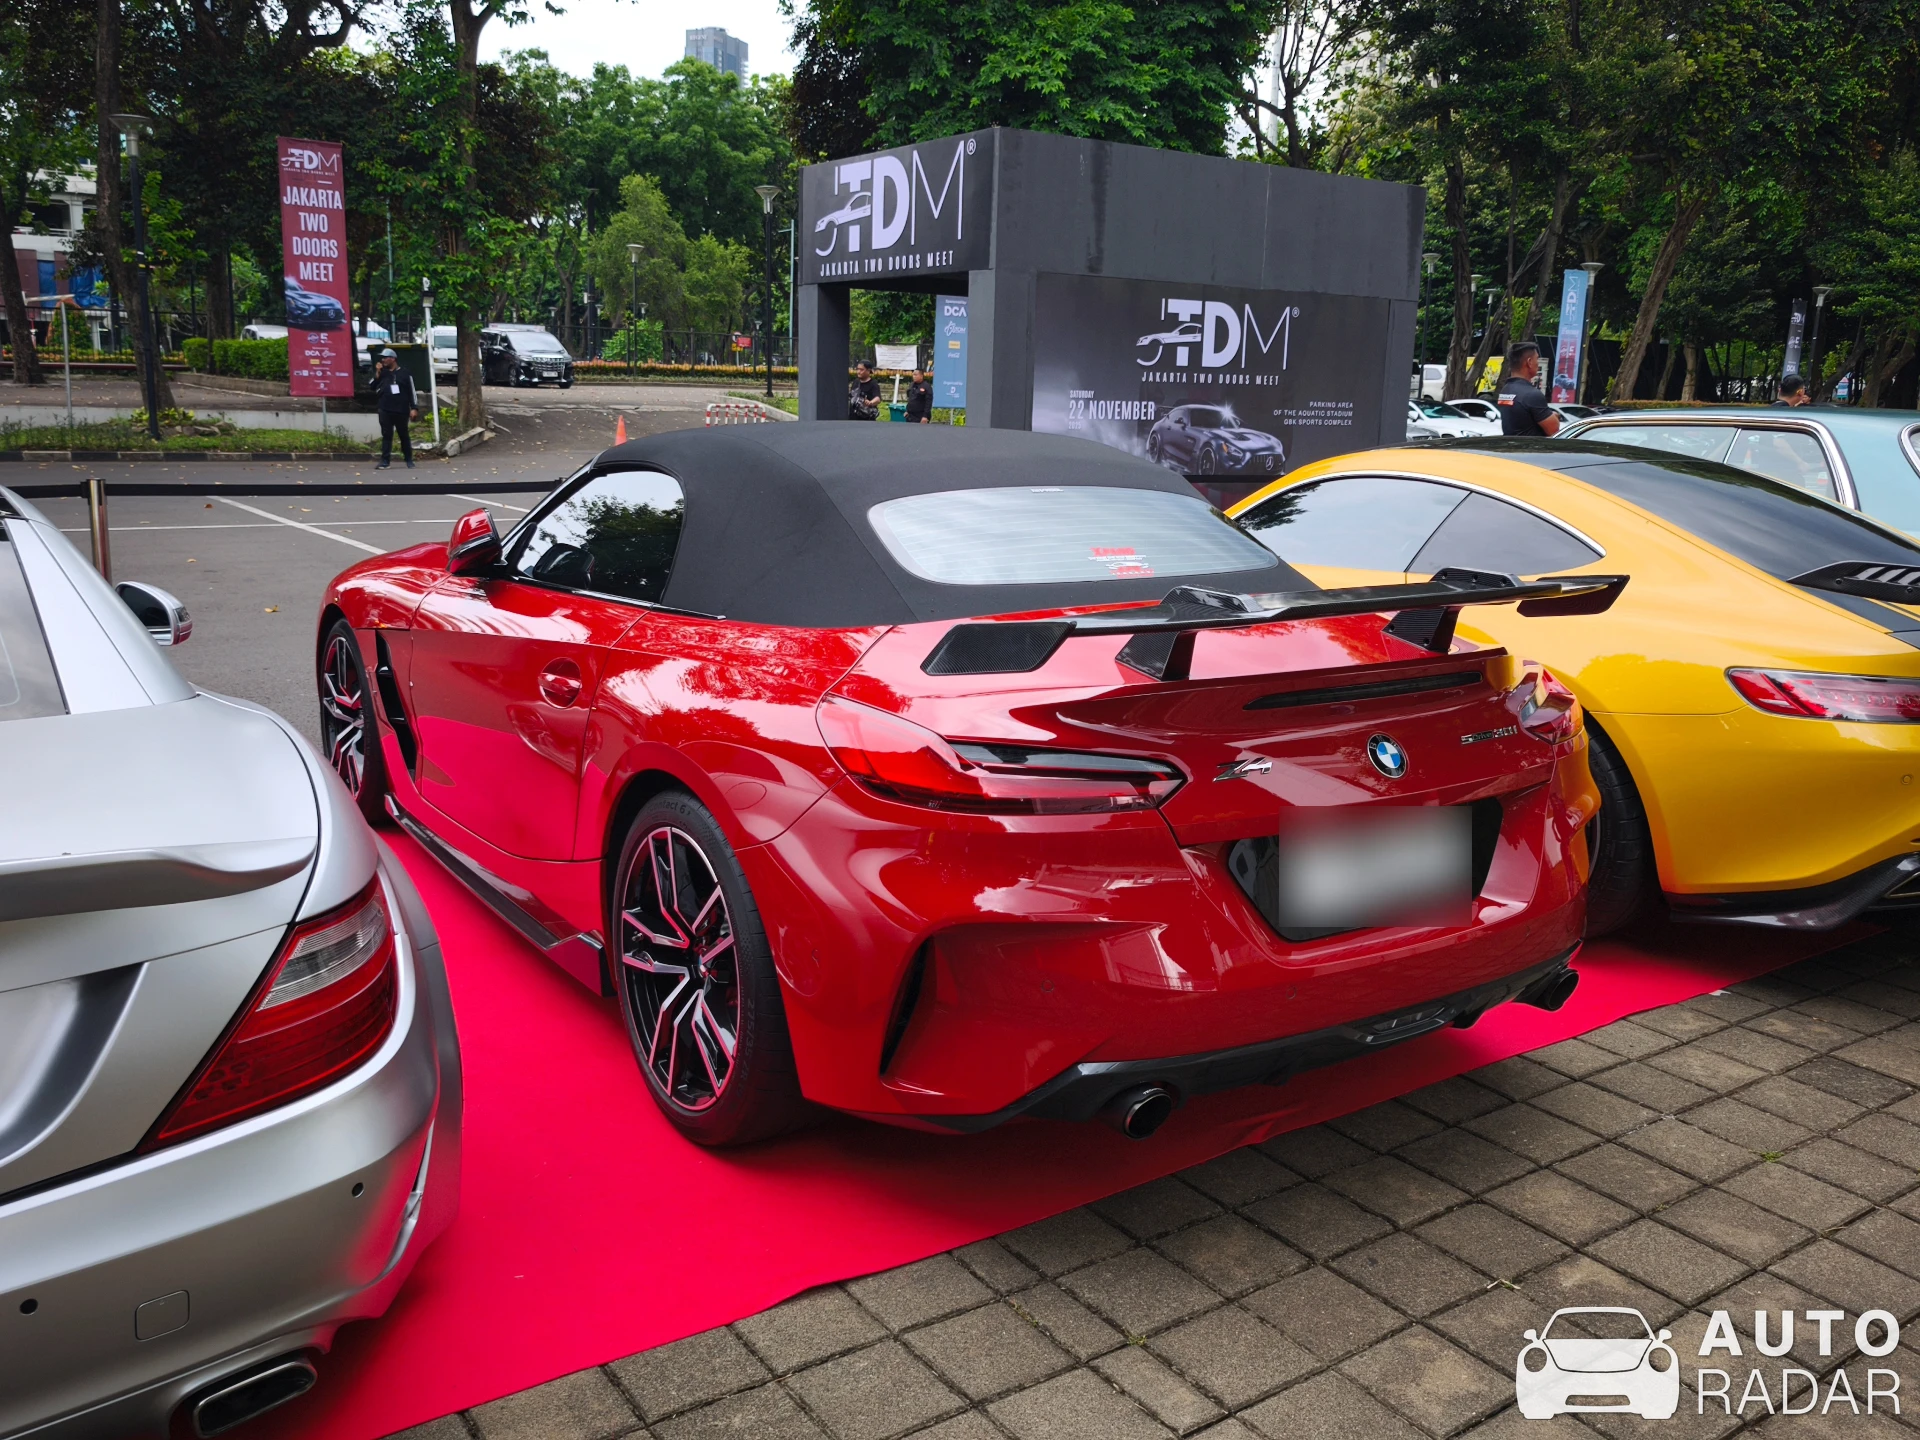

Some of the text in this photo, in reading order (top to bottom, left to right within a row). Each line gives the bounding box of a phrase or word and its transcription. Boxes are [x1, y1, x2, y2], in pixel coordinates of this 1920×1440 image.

[283, 185, 343, 210] JAKARTA
[298, 212, 328, 233] TWO
[292, 236, 339, 259] DOORS
[299, 261, 334, 282] MEET
[820, 250, 954, 277] JAKARTA TWO DOORS MEET
[944, 305, 967, 318] DCA
[1141, 371, 1280, 386] JAKARTA TWO DOORS MEET
[1069, 390, 1095, 399] SATURDAY
[1069, 400, 1156, 420] 22 NOVEMBER
[1068, 421, 1082, 430] 2025
